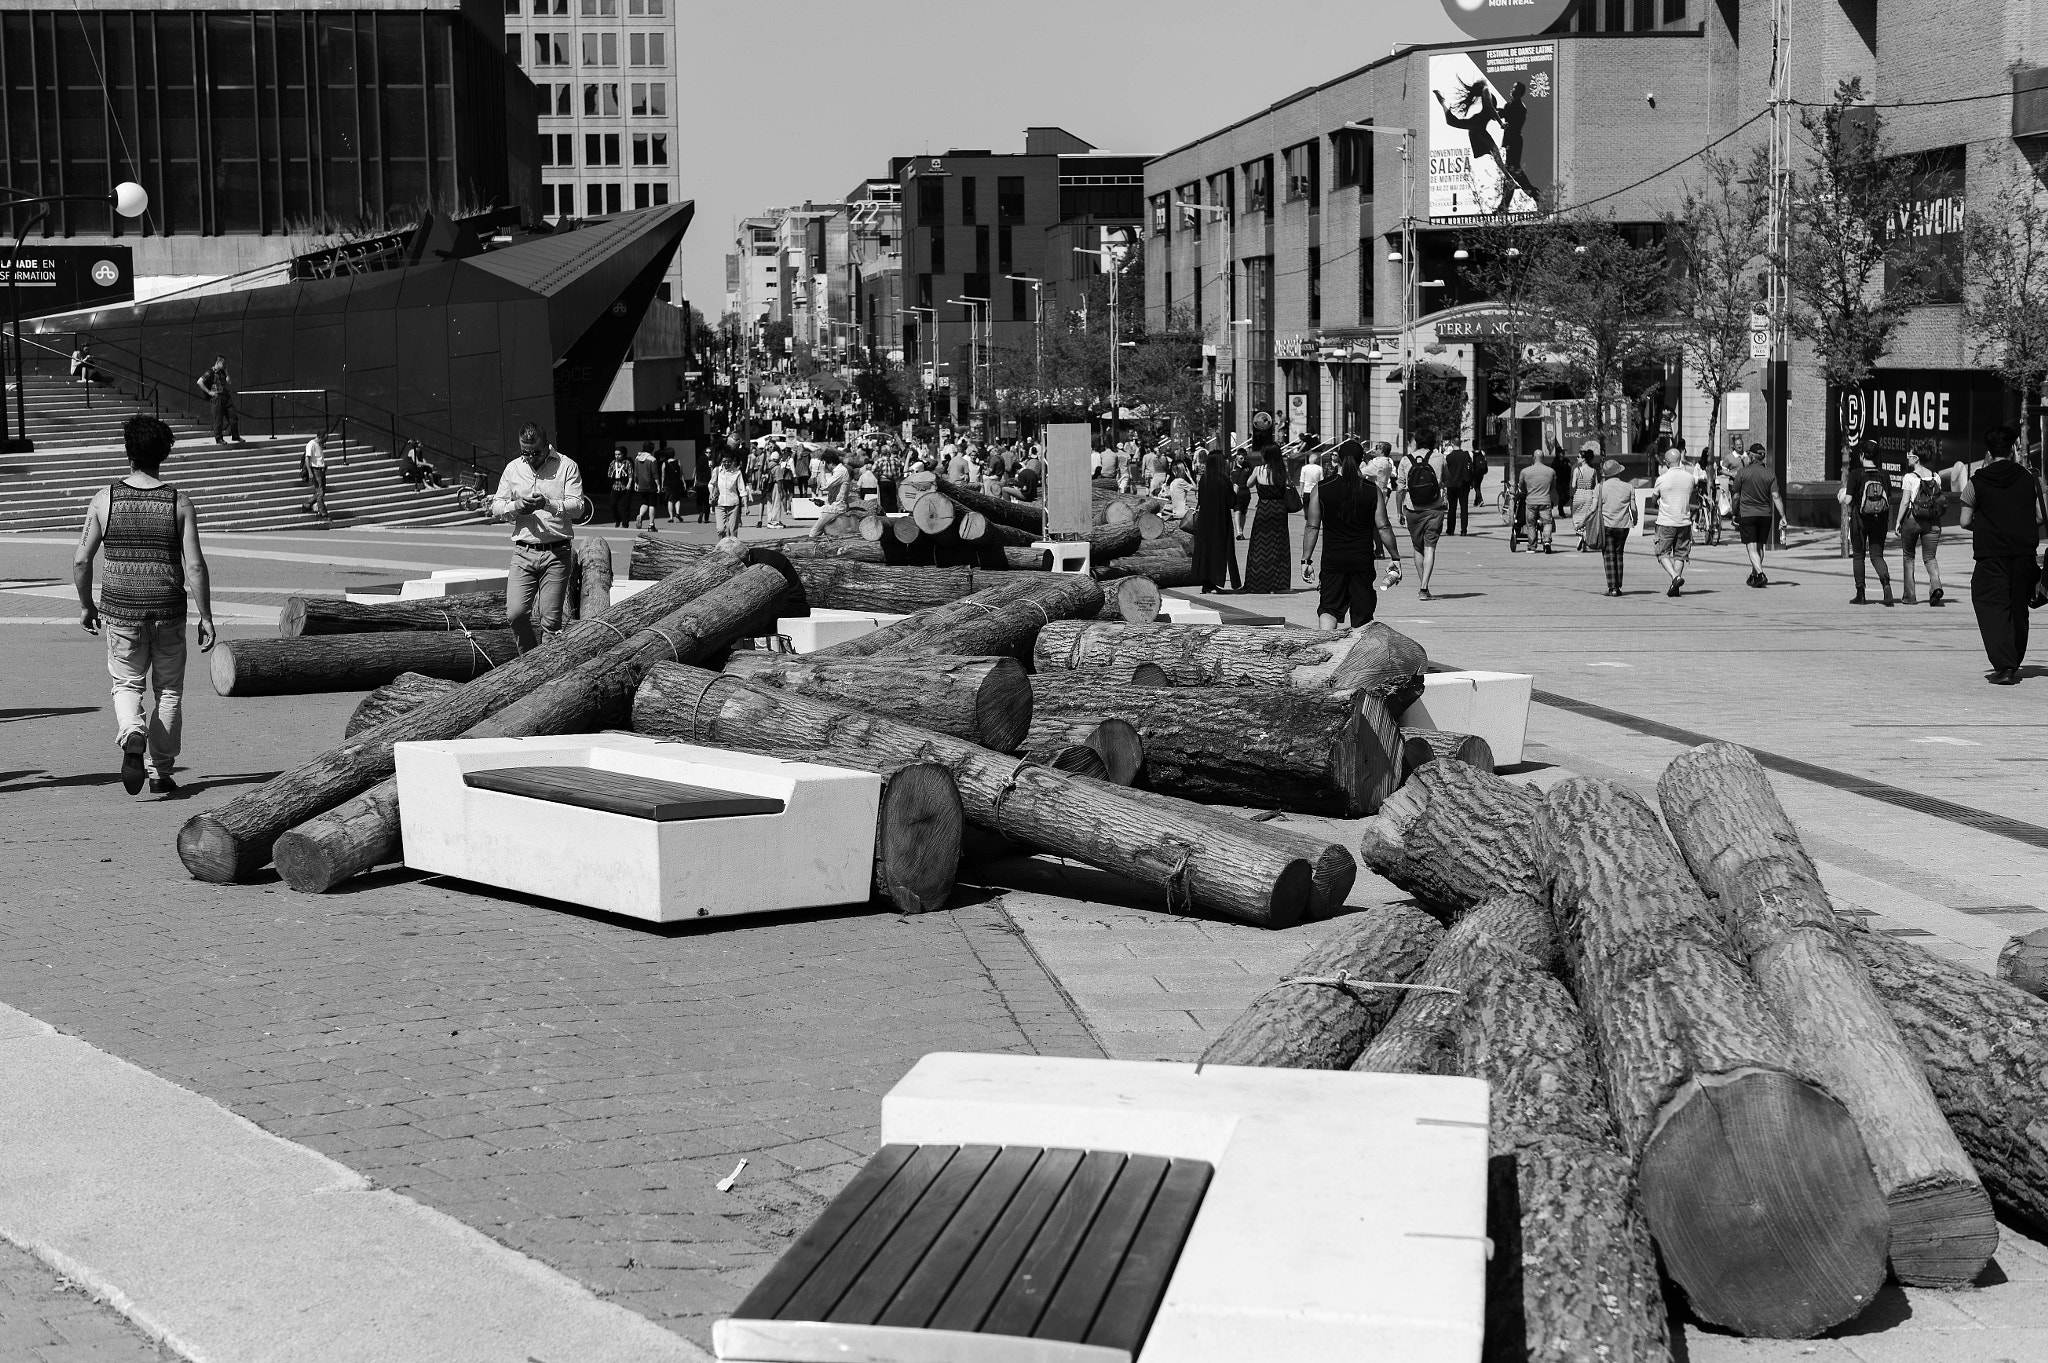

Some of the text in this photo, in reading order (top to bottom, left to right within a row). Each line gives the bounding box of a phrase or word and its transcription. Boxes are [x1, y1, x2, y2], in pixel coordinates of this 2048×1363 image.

[1487, 45, 1553, 59] FESTIVAL DE DANSE LATINE
[1430, 147, 1471, 158] CONVENTION DE
[1430, 156, 1471, 175] SALSA
[1430, 175, 1438, 184] DE
[850, 202, 880, 225] 22
[1912, 196, 1965, 238] AVOIR
[42, 259, 55, 269] EN
[0, 271, 56, 281] SFRMATION
[1437, 322, 1484, 336] TERRA
[1872, 389, 1950, 431] LA CAGE
[1879, 436, 1906, 452] ASSERIE
